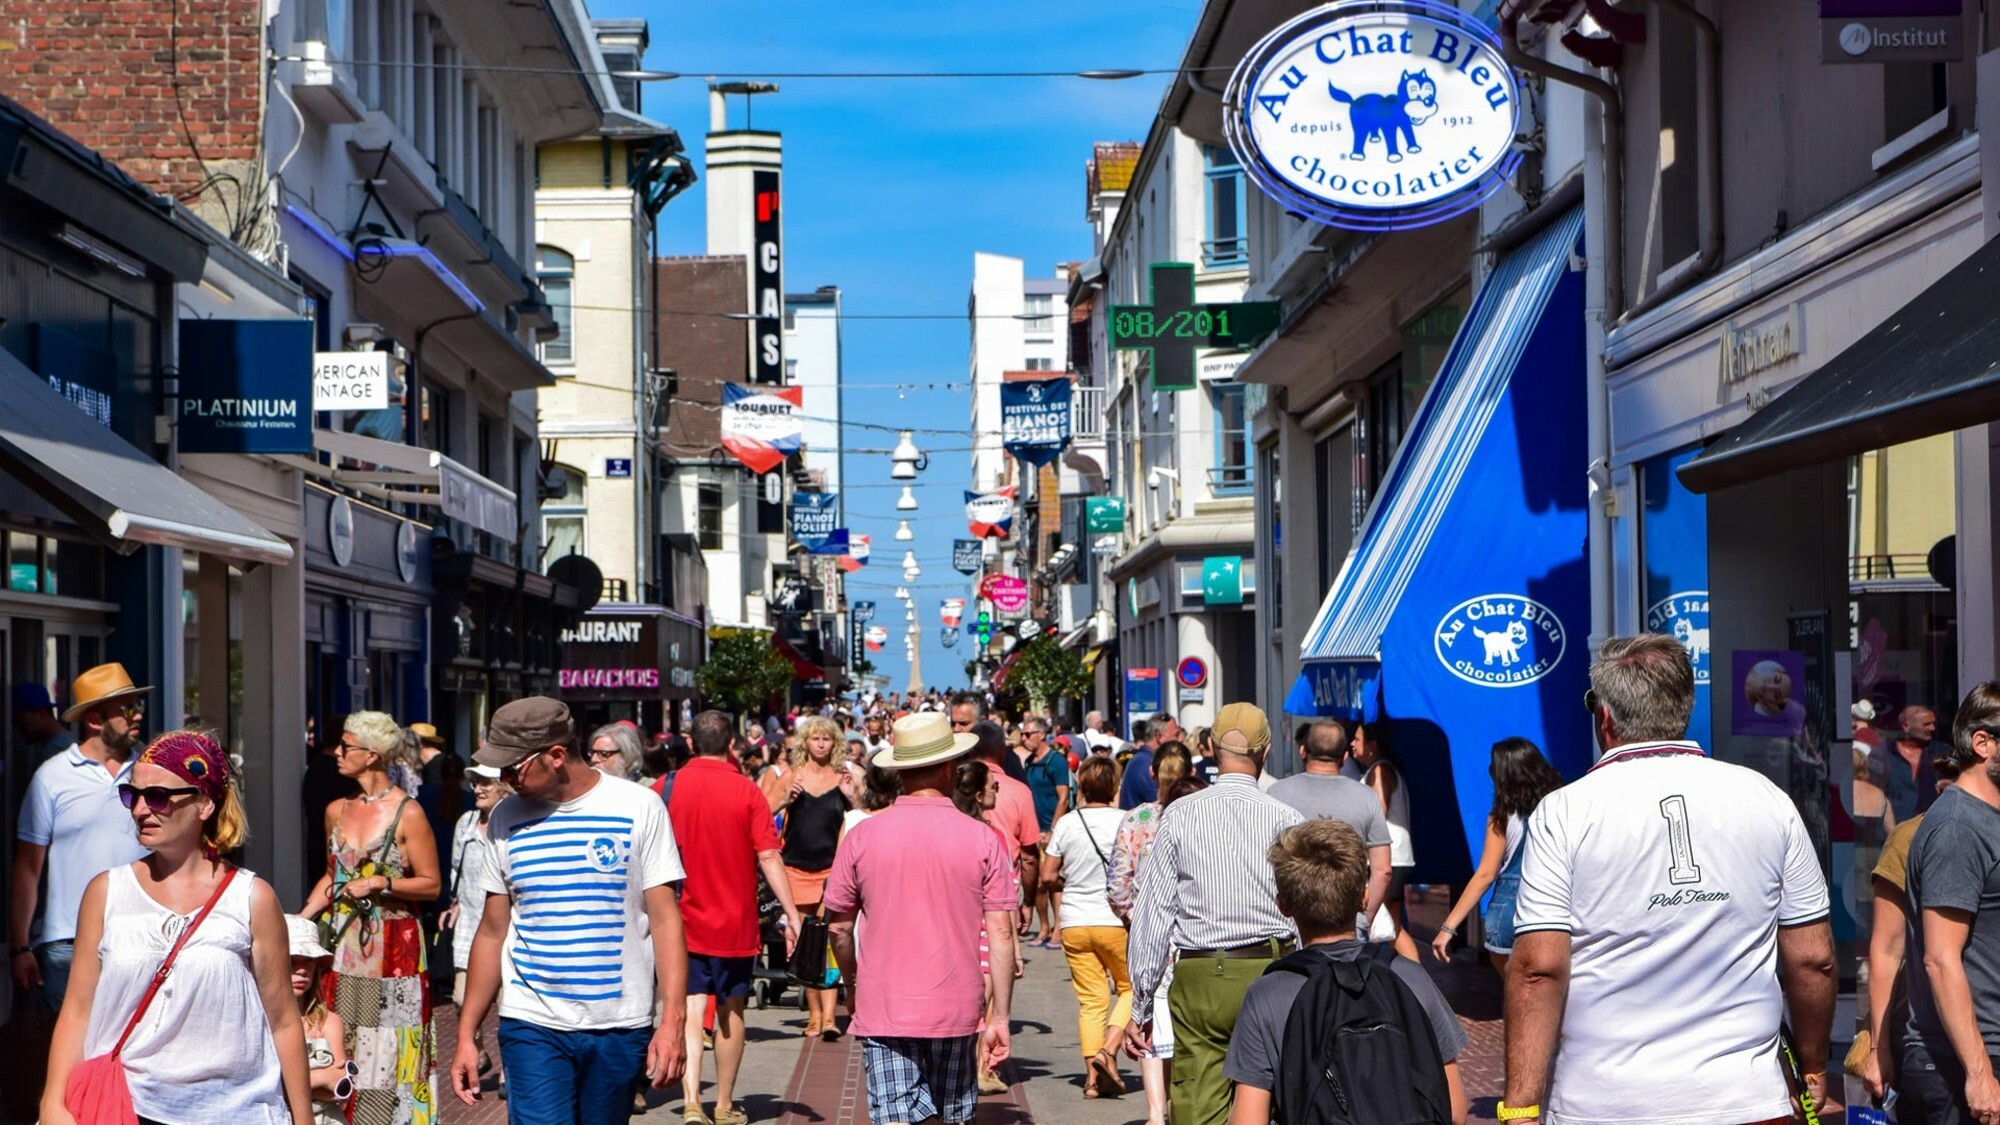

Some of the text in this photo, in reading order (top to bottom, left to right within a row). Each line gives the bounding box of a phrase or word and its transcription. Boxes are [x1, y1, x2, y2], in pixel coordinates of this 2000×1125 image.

[1872, 26, 1948, 47] Institut
[1257, 23, 1511, 124] Au Chat Bleu
[1290, 115, 1474, 134] depuis 1912
[1290, 143, 1485, 198] chocolatier
[1115, 310, 1233, 338] 08/201
[314, 364, 381, 380] MERICAN
[761, 241, 782, 505] CASO
[315, 383, 373, 398] INTAGE
[184, 399, 297, 418] PLATINIUM
[734, 403, 793, 416] TOUQUET
[1004, 403, 1048, 415] FESTIVAL
[259, 419, 297, 429] Femmes
[1004, 411, 1068, 429] PIANOS
[793, 513, 835, 523] PIANOS
[793, 522, 834, 533] FOLIES
[1439, 600, 1561, 648] Au Chat Bleu
[559, 668, 660, 688] BARACHOIS
[1455, 657, 1549, 682] chocolatier
[1659, 794, 1702, 886] 1
[1647, 889, 1731, 911] Polo Team
